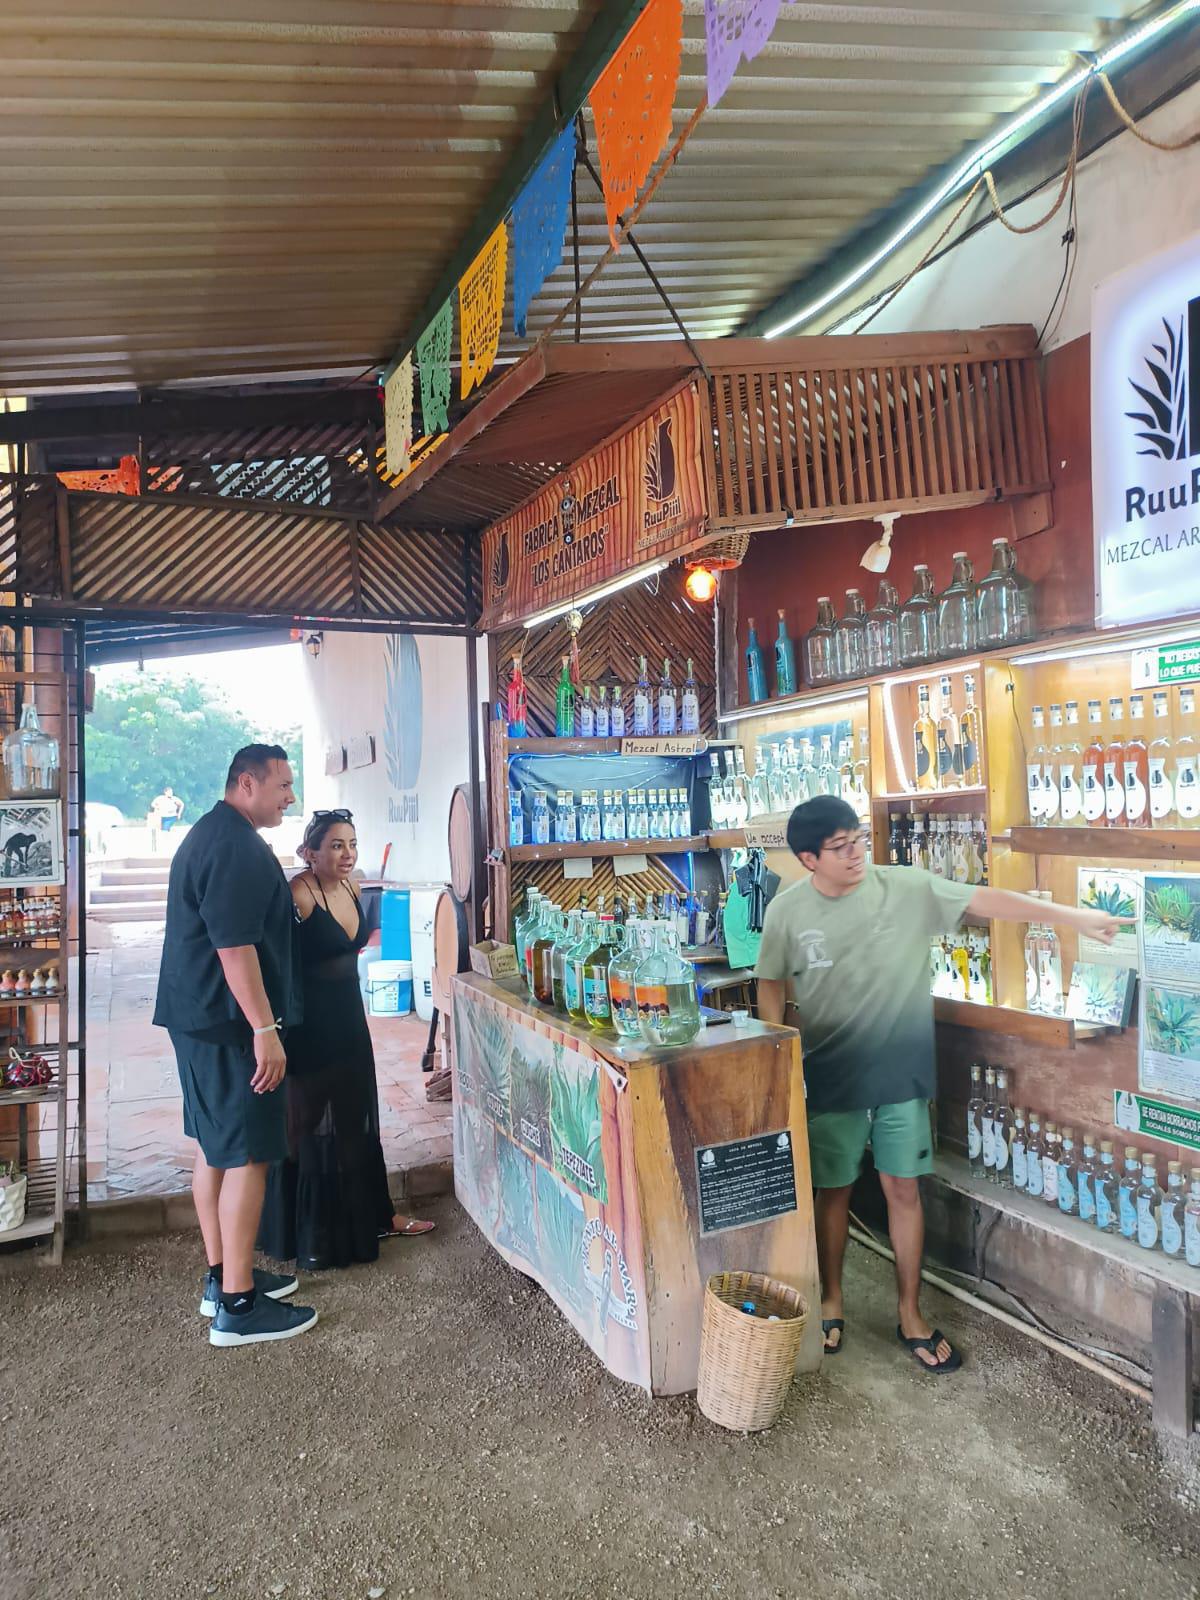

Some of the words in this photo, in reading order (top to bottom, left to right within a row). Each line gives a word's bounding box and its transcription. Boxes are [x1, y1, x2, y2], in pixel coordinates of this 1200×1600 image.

[524, 516, 560, 556] FABRICA
[576, 476, 620, 525] MEZCAL
[1106, 533, 1174, 565] MEZCAL
[1170, 665, 1186, 677] QUE
[625, 742, 658, 753] Mezcal
[664, 742, 696, 753] Astral
[561, 1146, 596, 1186] TEPEZTATE
